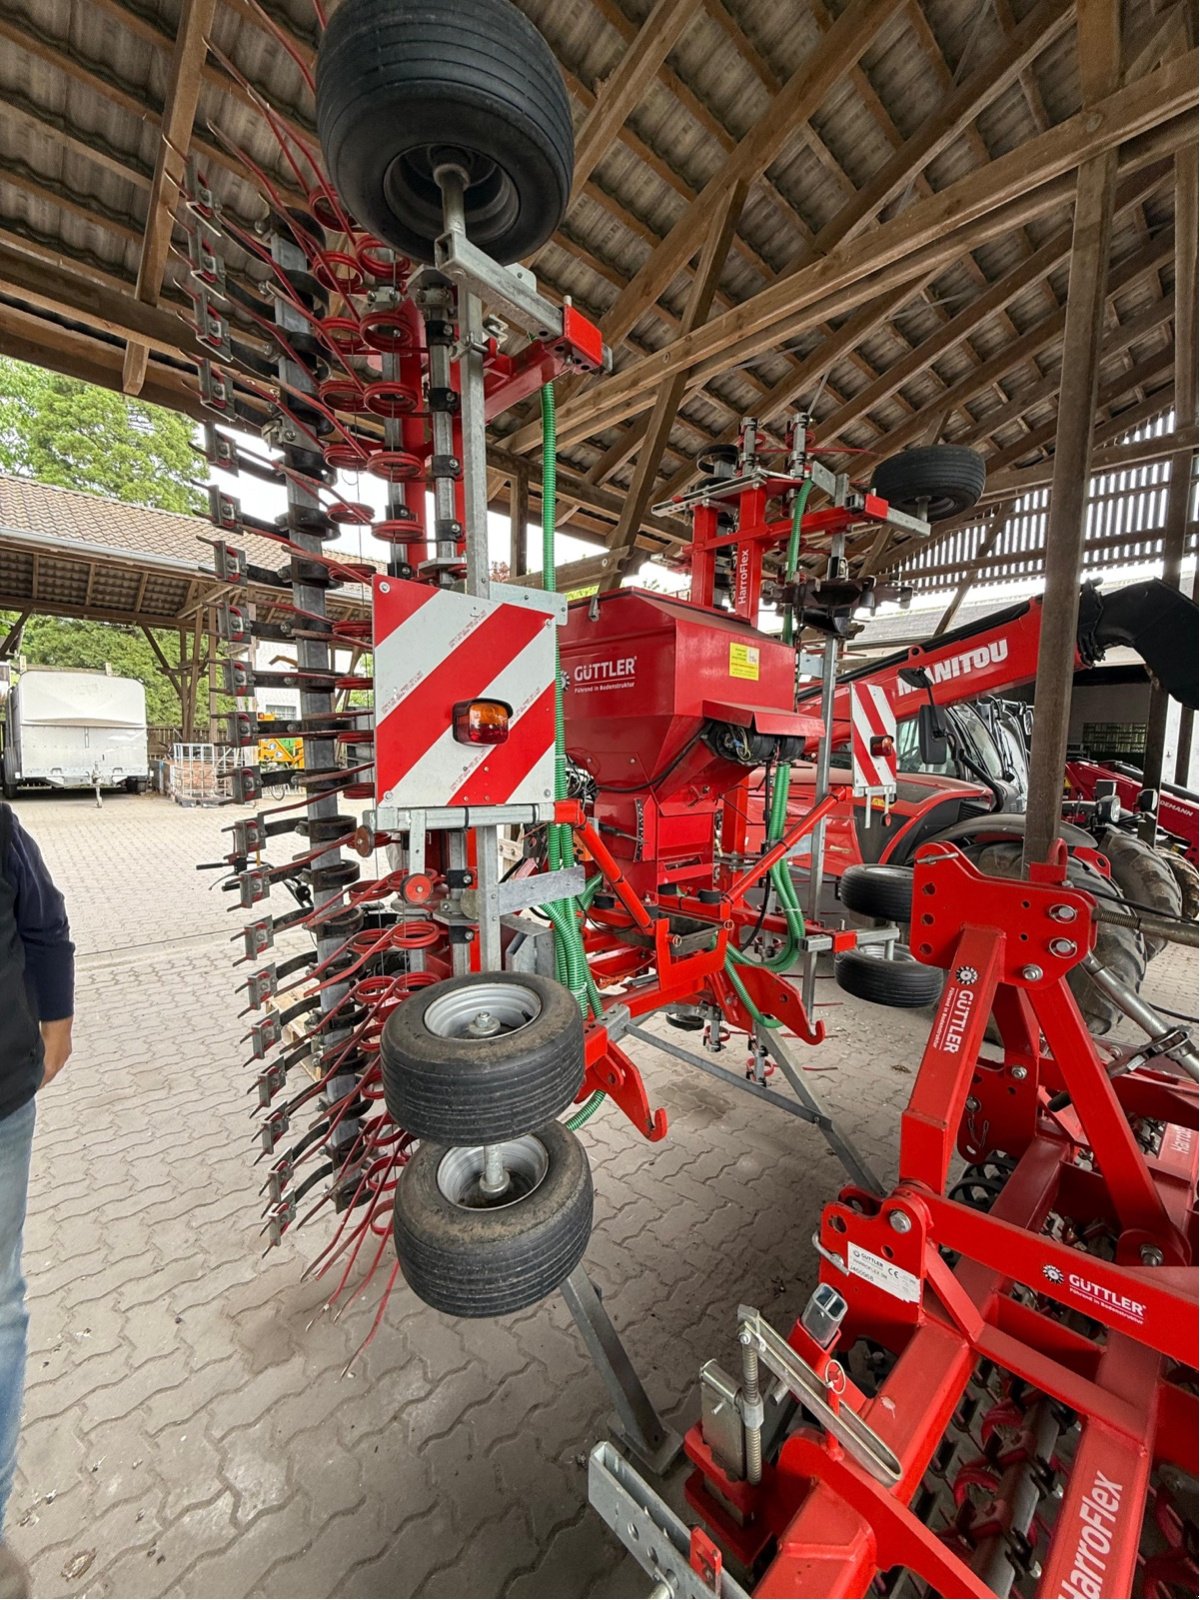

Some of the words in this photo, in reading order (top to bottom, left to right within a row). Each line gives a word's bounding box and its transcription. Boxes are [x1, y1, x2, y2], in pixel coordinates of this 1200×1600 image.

[738, 549, 749, 604] HarroFlex
[574, 657, 635, 681] GÜTTLER
[600, 682, 635, 690] Bodenstruktur
[1160, 800, 1194, 817] DEMANN
[943, 990, 973, 1053] GÜTTLER
[1069, 1274, 1144, 1316] GÜTTLER
